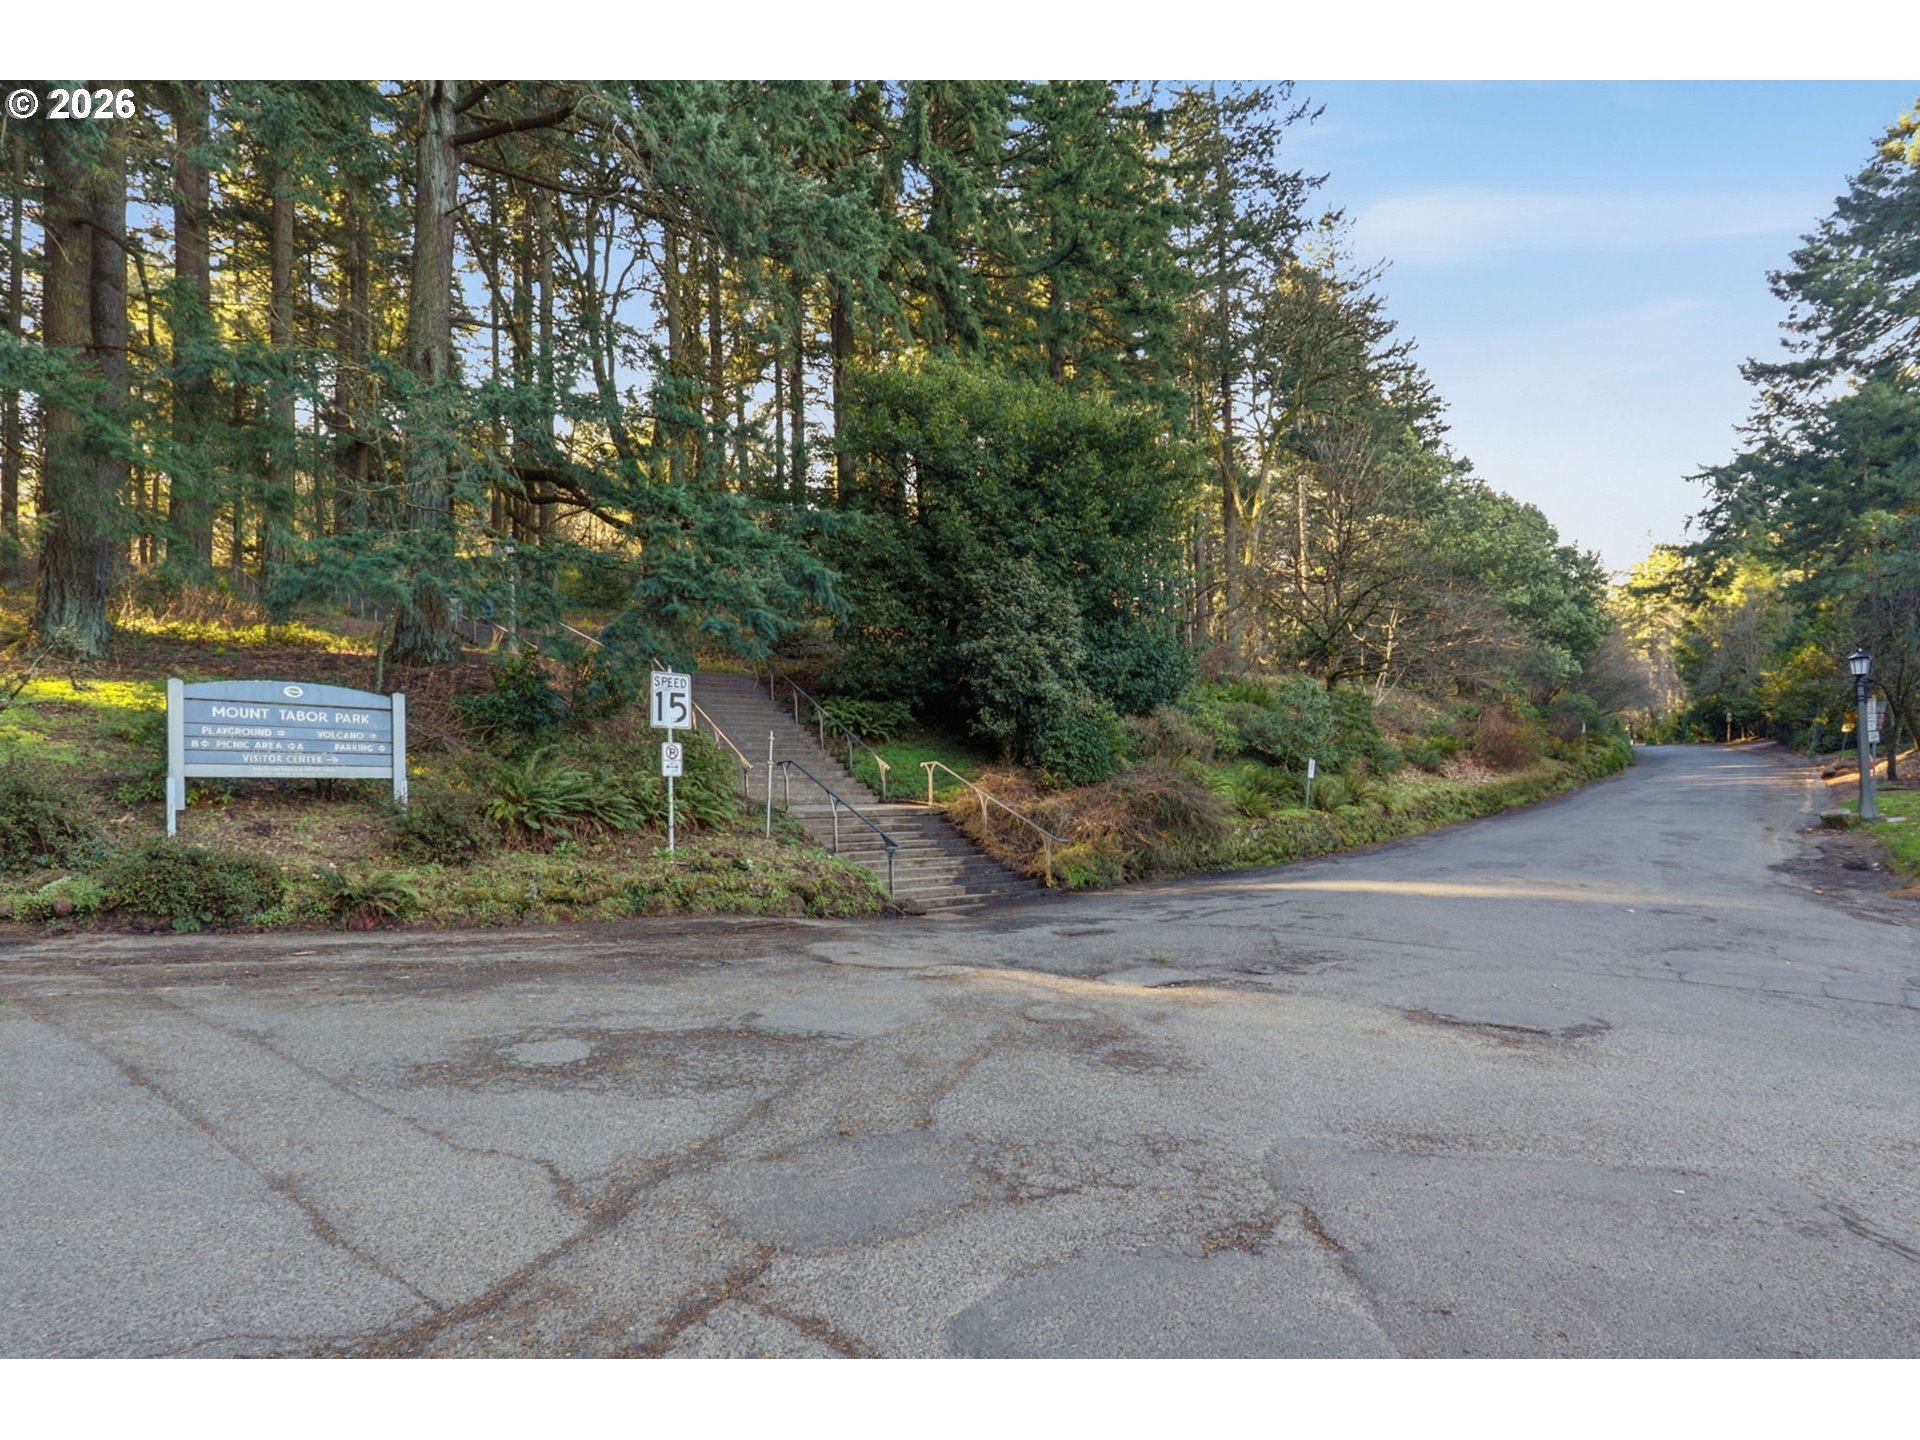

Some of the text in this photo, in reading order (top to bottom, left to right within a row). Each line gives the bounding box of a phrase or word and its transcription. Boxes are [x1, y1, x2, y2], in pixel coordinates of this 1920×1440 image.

[654, 676, 687, 689] SPEED
[655, 691, 687, 723] 15
[212, 706, 369, 725] MOUNT TABOR PARK
[201, 726, 272, 737] PLAYGROUND
[316, 731, 365, 740] VOLCANO
[191, 740, 304, 751] B PICNIC AREA A
[334, 743, 374, 752] PARKING
[242, 754, 323, 764] VISITOR CENTER
